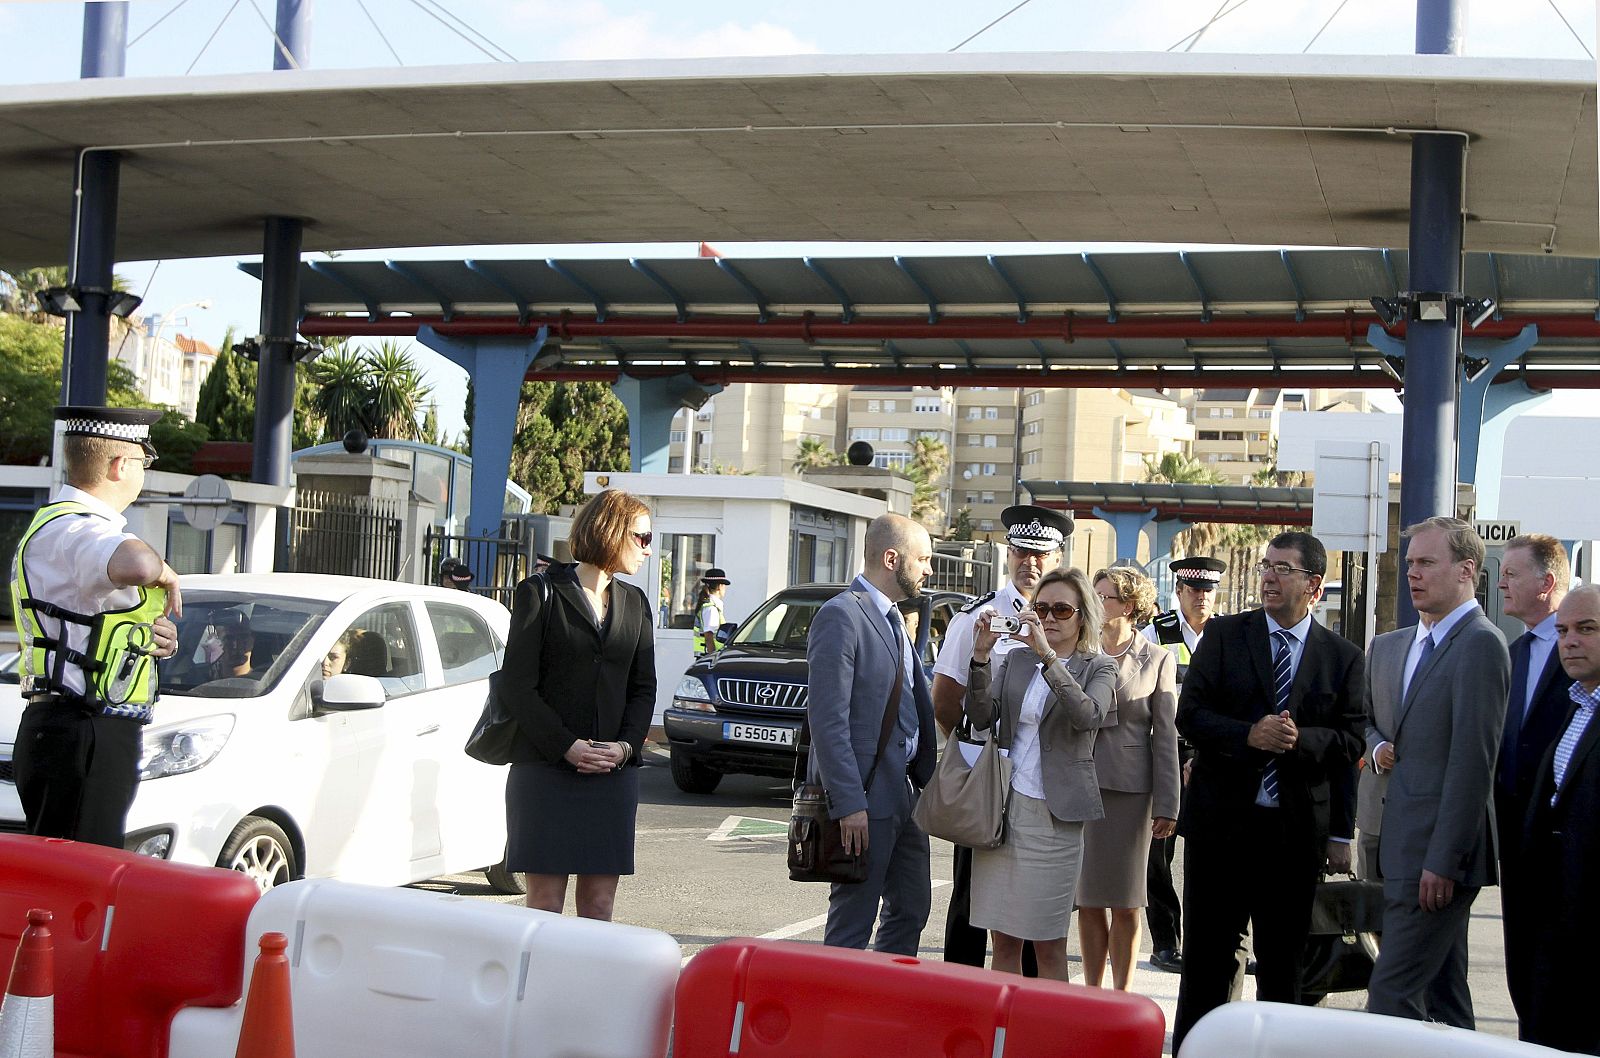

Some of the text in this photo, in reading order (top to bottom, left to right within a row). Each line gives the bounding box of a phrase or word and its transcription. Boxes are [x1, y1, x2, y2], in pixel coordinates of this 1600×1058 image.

[1473, 524, 1516, 540] LICIA
[734, 726, 742, 738] G
[745, 727, 777, 741] 5505
[780, 731, 787, 743] A
